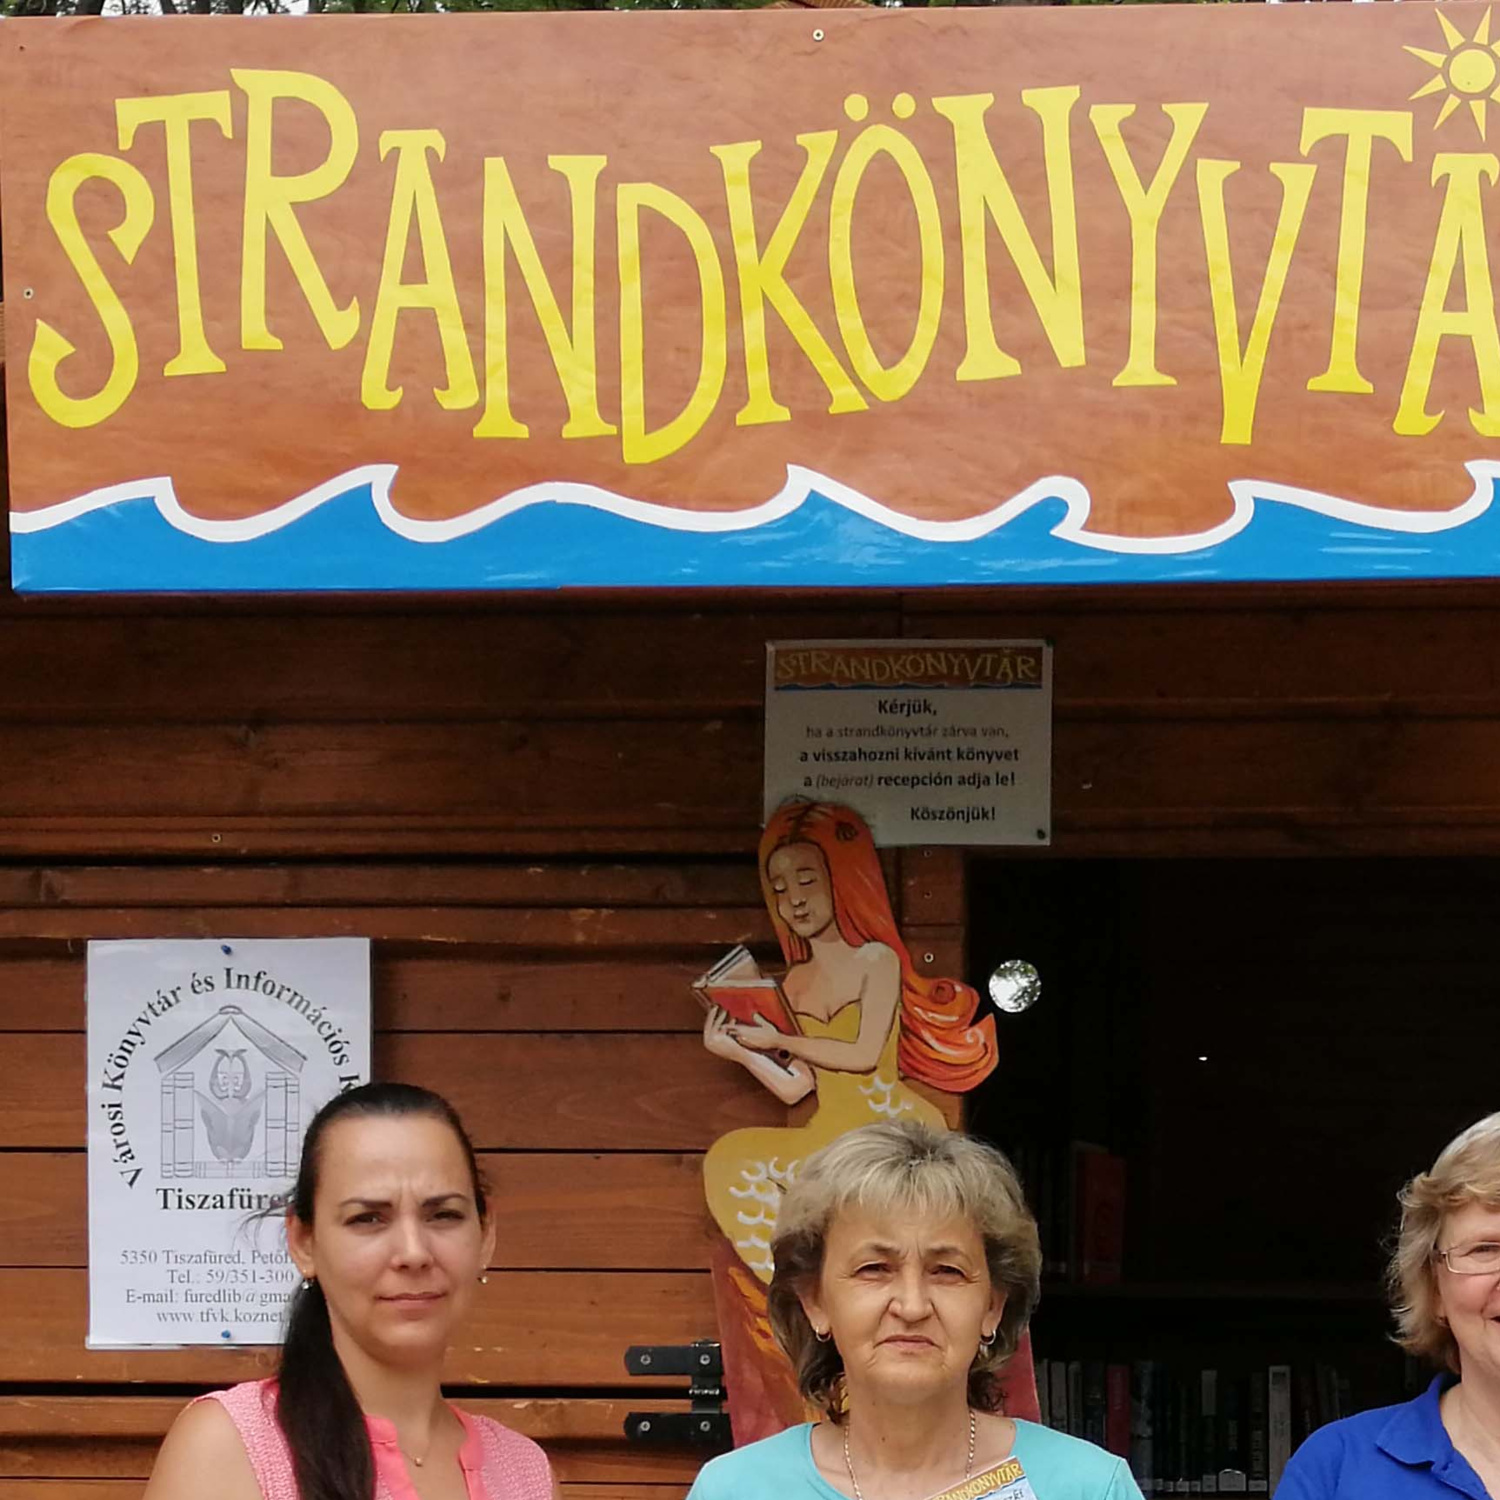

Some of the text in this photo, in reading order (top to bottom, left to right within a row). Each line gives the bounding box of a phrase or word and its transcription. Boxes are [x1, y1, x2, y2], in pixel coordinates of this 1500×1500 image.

[878, 699, 937, 717] Kérjük,
[806, 725, 1010, 740] ha a strandkönyvtár zárva van,
[800, 751, 808, 762] a
[812, 748, 899, 762] visszahozni
[956, 747, 1020, 765] könyvet
[803, 776, 812, 787] a
[877, 772, 952, 789] recepción
[957, 772, 990, 789] adja
[995, 772, 1015, 787] le!
[910, 806, 996, 824] Köszönjük!
[101, 967, 350, 1190] Városi Könyvtár és Információs
[156, 1187, 283, 1211] Tiszafüre
[120, 1250, 157, 1265] 5350
[162, 1249, 245, 1266] Tiszafüred,
[126, 1289, 178, 1304] E-mail:
